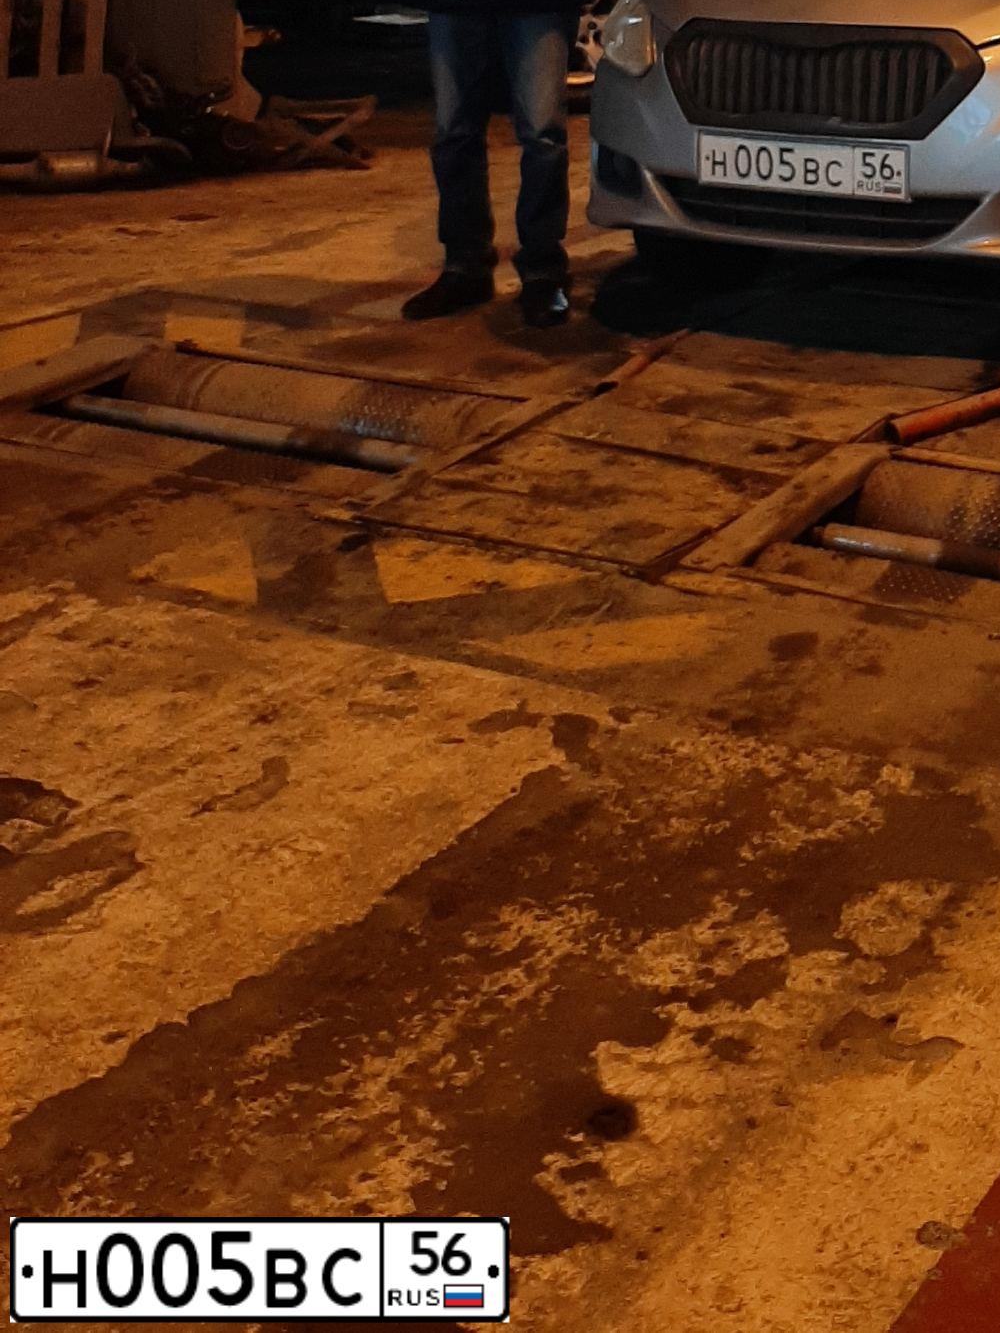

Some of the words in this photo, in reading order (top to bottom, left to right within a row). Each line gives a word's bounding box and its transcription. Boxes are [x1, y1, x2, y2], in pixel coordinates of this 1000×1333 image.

[711, 144, 843, 187] Н005ВС
[862, 152, 895, 180] 56
[856, 180, 882, 193] RUS
